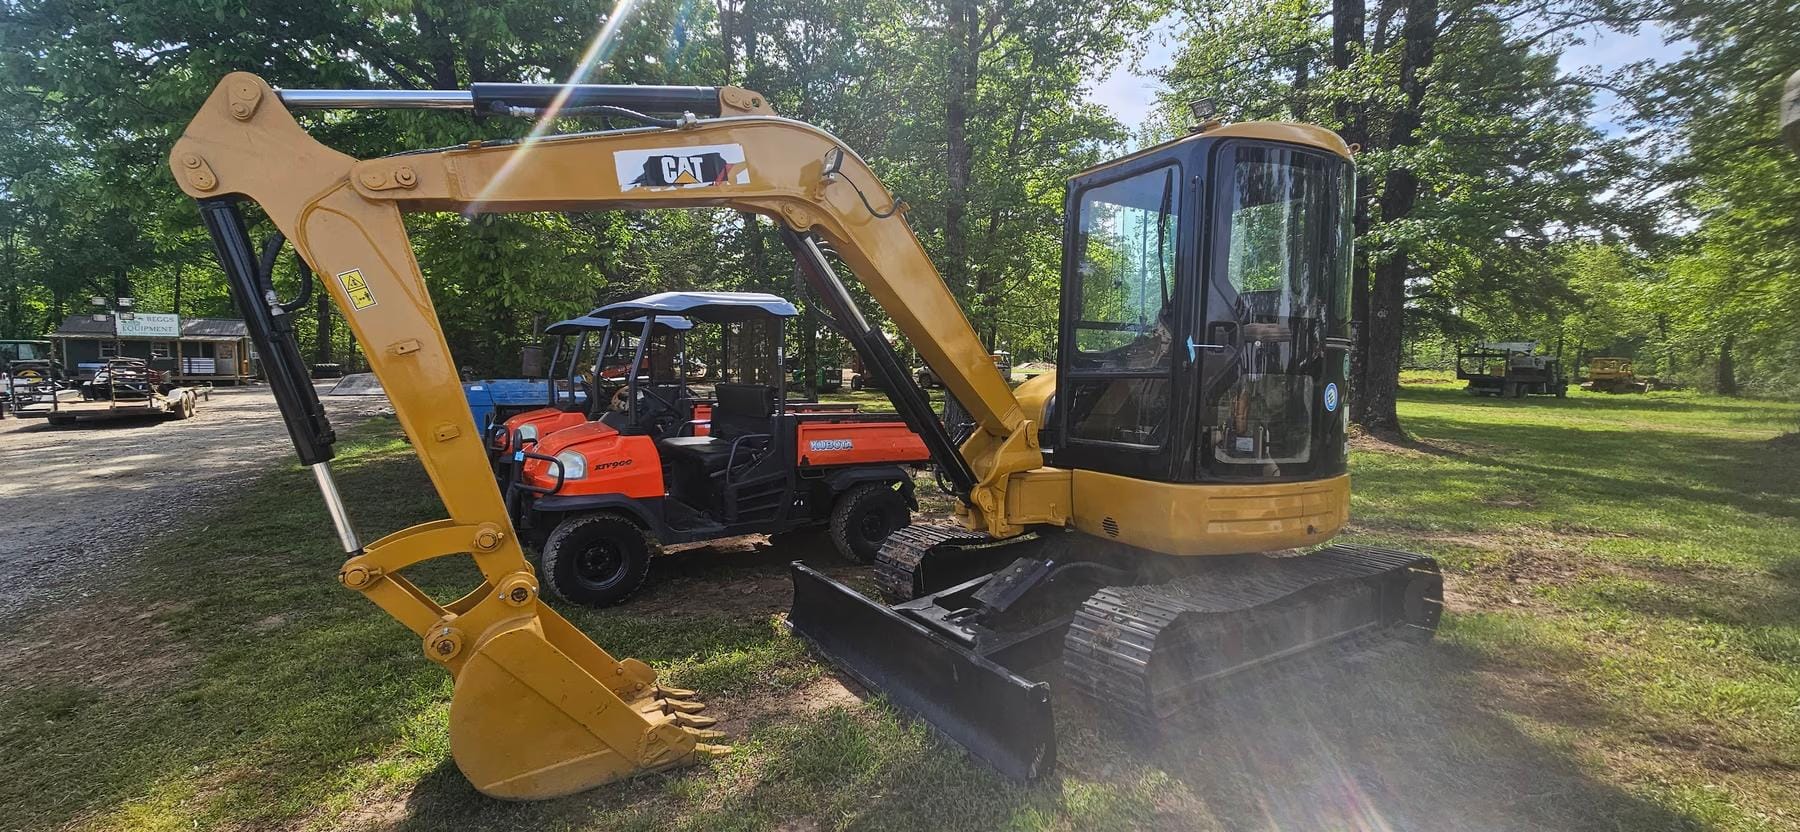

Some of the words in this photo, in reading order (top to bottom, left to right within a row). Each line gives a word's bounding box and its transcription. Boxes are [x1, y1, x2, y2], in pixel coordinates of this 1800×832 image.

[661, 156, 703, 184] CAT
[810, 440, 853, 451] KUBOTA
[594, 459, 632, 471] RTV900
